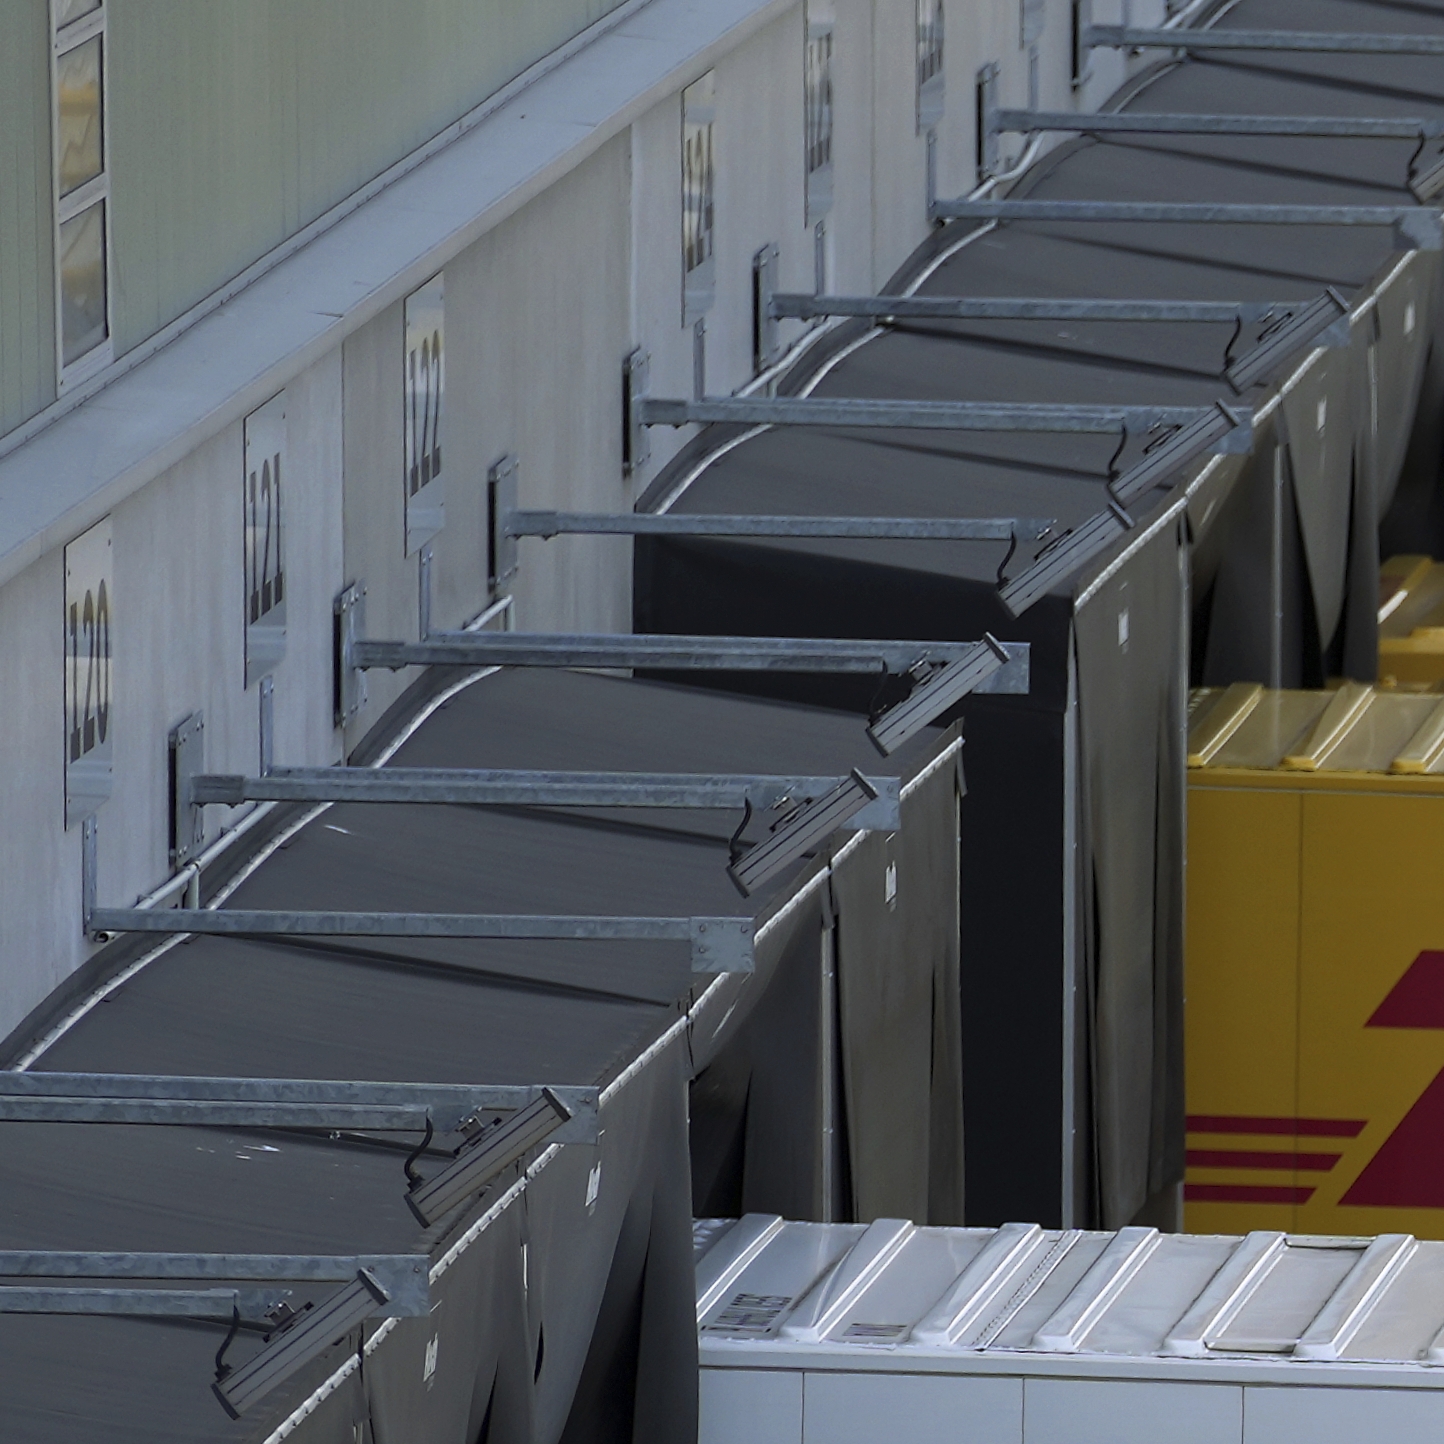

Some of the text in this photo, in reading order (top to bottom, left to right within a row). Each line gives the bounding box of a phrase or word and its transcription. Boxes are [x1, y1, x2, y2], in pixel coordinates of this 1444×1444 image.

[409, 329, 441, 498] 122
[250, 452, 283, 626] 121
[70, 577, 108, 763] 120
